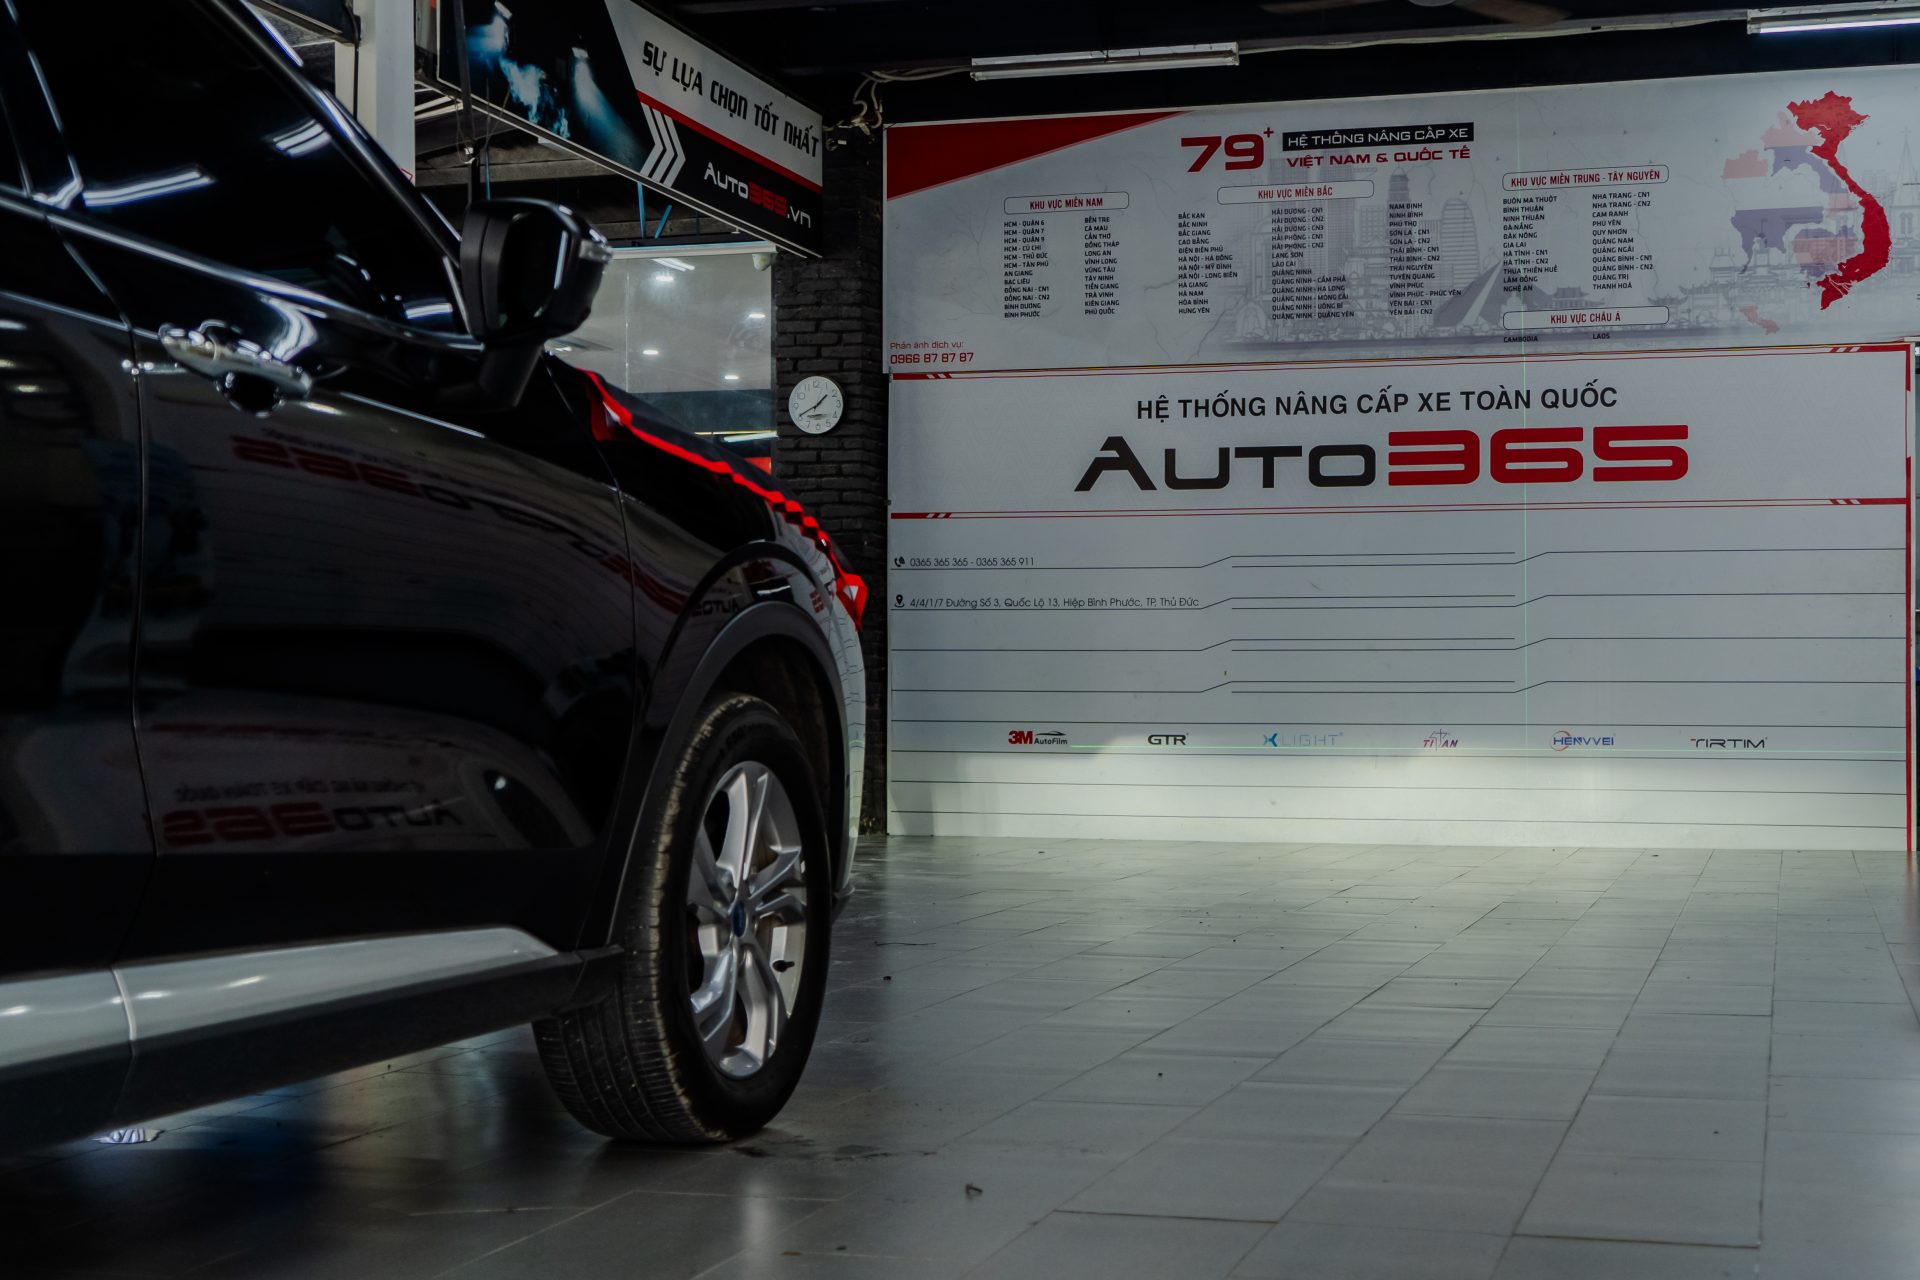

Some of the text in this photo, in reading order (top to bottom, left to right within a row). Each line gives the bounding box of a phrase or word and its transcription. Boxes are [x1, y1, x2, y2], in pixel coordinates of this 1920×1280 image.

[643, 41, 819, 157] SỰ LỰA CHỌN TỐT NHẤT
[1288, 124, 1468, 148] HỆ THỐNG NÂNG CẤP XE
[1287, 145, 1470, 169] VIỆT NAM & QUỐC TẾ
[1511, 178, 1528, 187] KHU
[1531, 176, 1547, 187] VỰC
[1550, 172, 1570, 184] MIỀN
[1574, 174, 1600, 183] TRUNG
[1608, 170, 1623, 181] TÂY
[1627, 169, 1660, 181] NGUYÊN
[1258, 190, 1274, 199] KHU
[1277, 189, 1292, 200] VỰC
[1317, 185, 1333, 197] BẮC
[1030, 200, 1044, 210] KHU
[1086, 198, 1103, 207] NAM
[1551, 313, 1567, 324] KHU
[1571, 312, 1587, 325] VỰC
[1590, 310, 1612, 322] CHÂU
[932, 341, 948, 350] dịch
[890, 352, 974, 364] 0966 87 87 87
[1137, 377, 1618, 423] HỆ THỐNG NÂNG CẤP XE TOÀN QUỐC
[1074, 424, 1690, 493] AUTO365
[910, 557, 932, 567] 0365
[933, 557, 950, 567] 365
[952, 557, 968, 566] 365
[976, 557, 997, 566] 0365
[1000, 557, 1017, 566] 365
[1019, 557, 1034, 566] 911
[910, 598, 943, 608] 4/4/1/7
[979, 597, 991, 608] Số
[1004, 596, 1031, 608] Quốc
[1034, 598, 1044, 608] Lộ
[1064, 597, 1085, 610] Hiệp
[1088, 597, 1107, 607] Bình
[1160, 596, 1178, 607] Thủ
[1179, 596, 1199, 607] Đức
[1008, 730, 1068, 745] 3M AutoFilm
[1147, 734, 1187, 746] GTR
